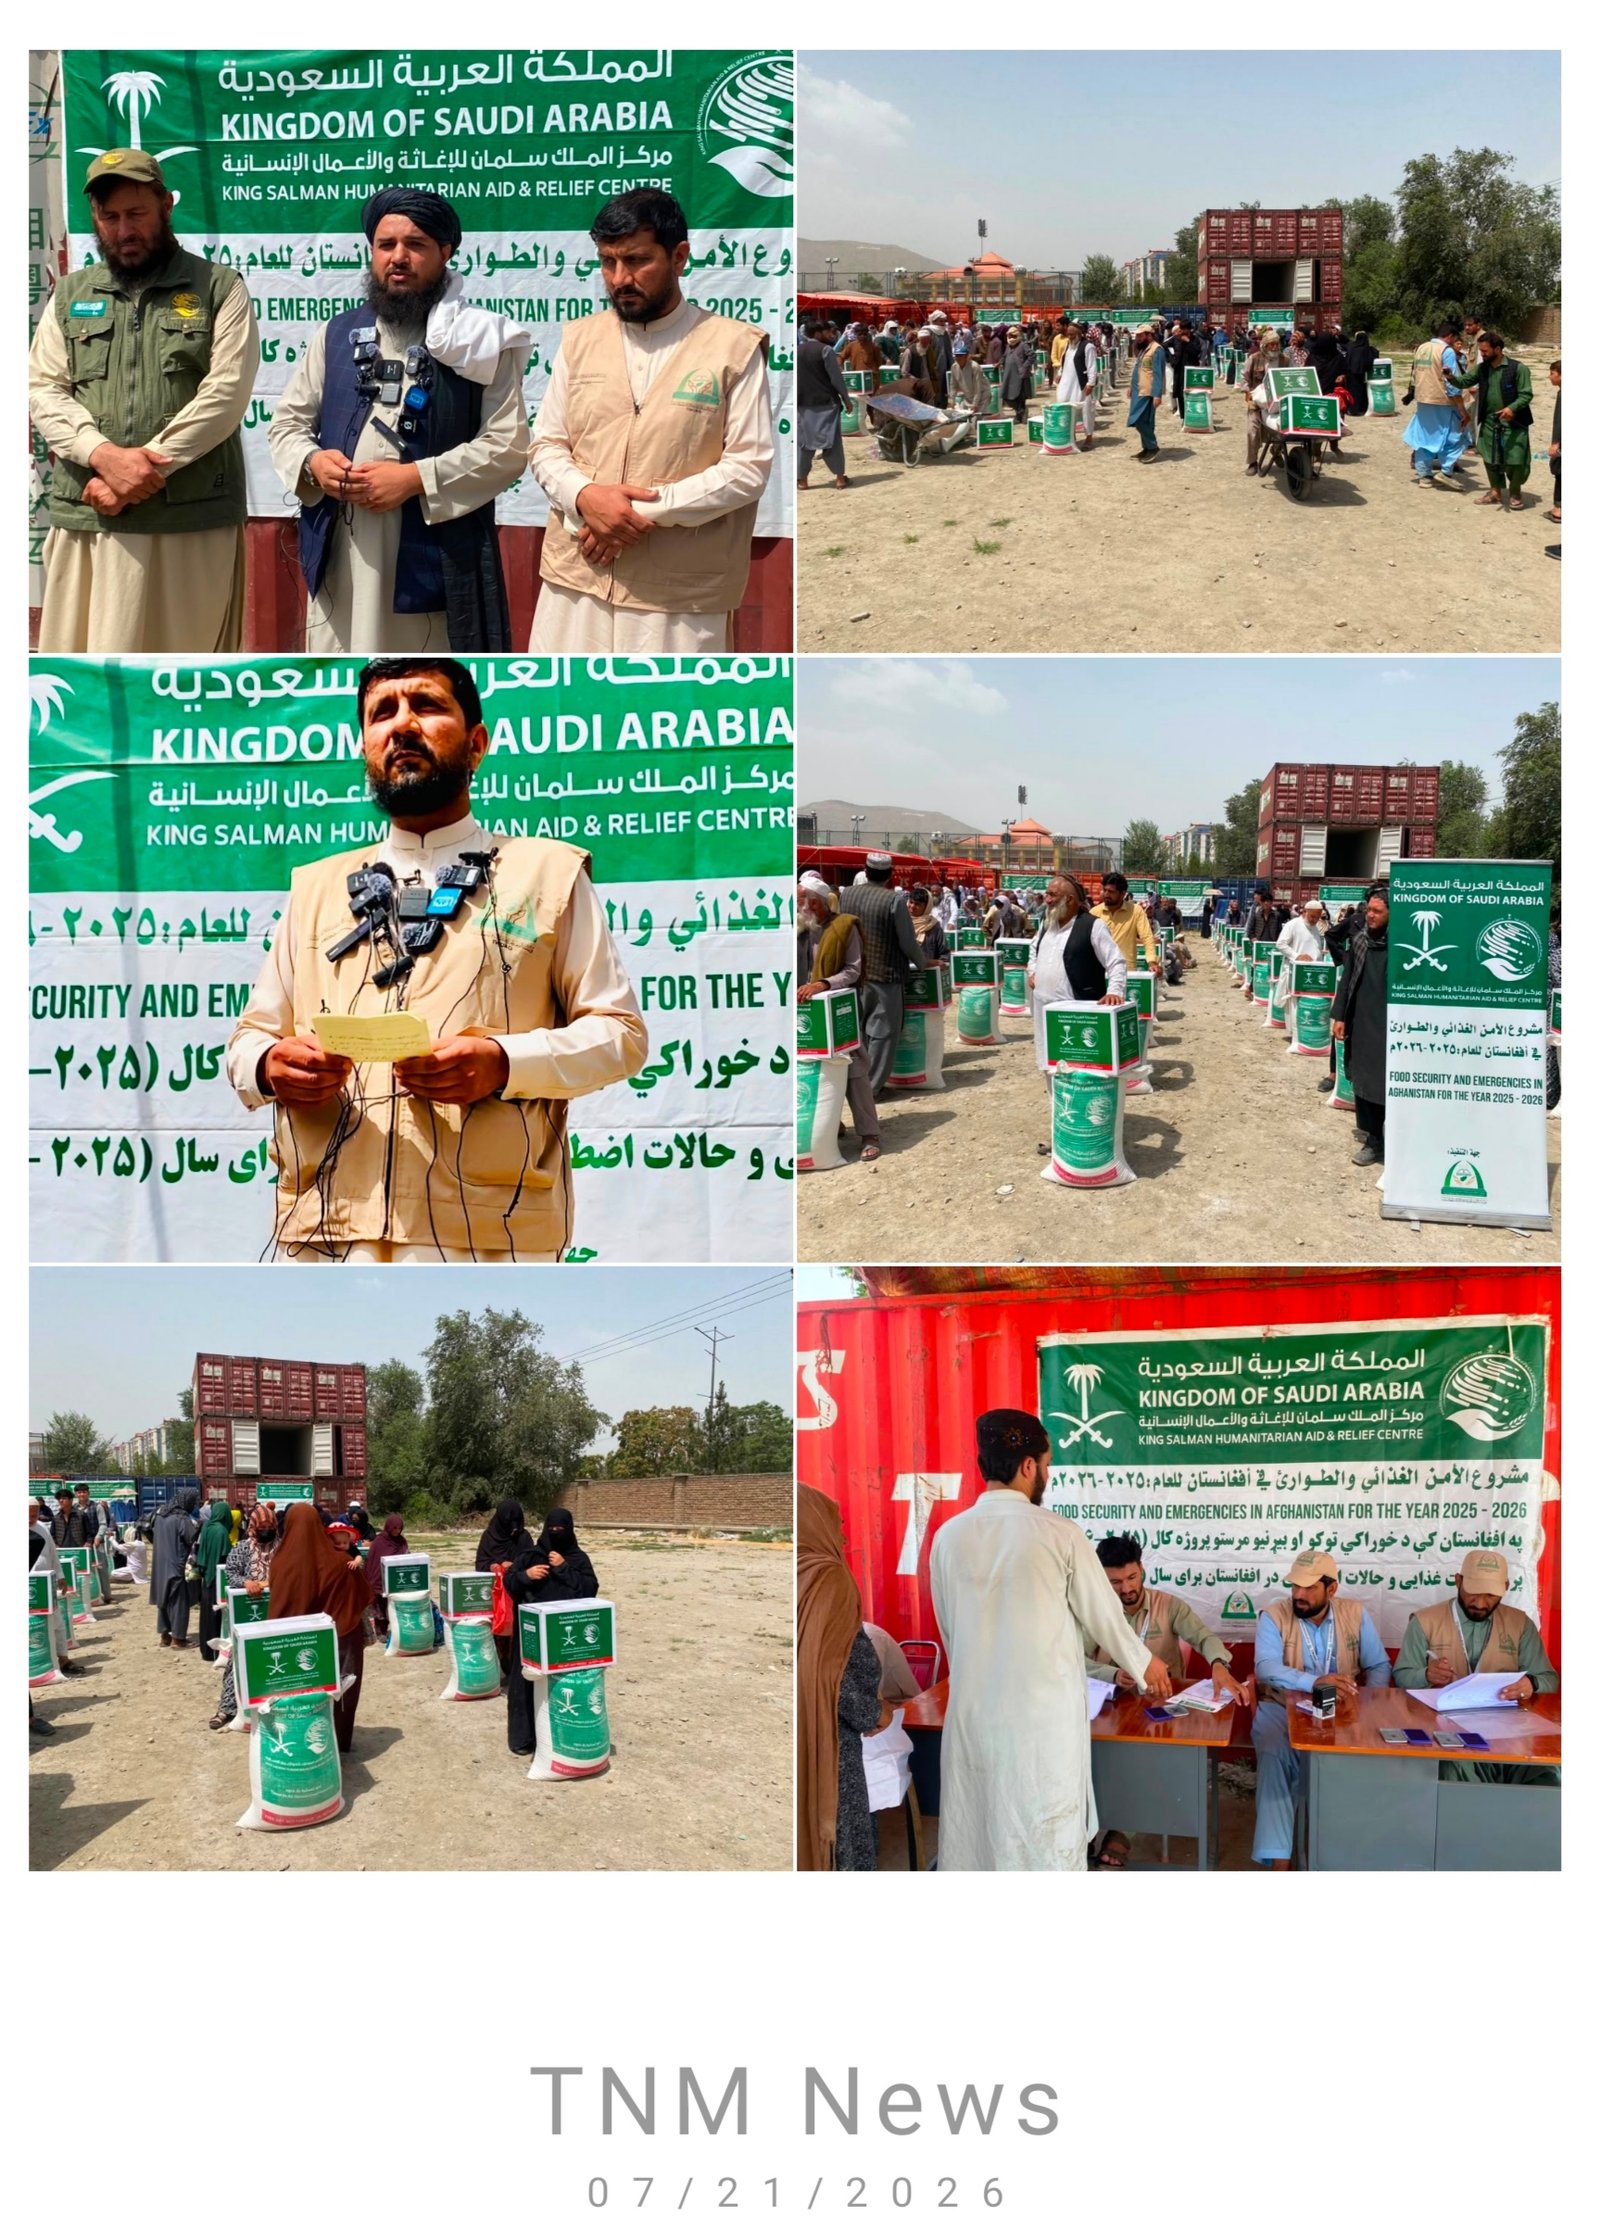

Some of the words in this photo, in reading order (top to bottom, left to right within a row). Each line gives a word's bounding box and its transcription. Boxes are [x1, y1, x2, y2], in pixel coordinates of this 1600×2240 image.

[524, 49, 672, 83] المملكة
[744, 50, 766, 61] CENTRE
[218, 59, 383, 101] السعودية
[393, 53, 512, 96] العربية
[221, 110, 375, 141] KINGDOM
[383, 108, 425, 137] OF
[434, 105, 534, 136] SAUDI
[543, 100, 673, 133] ARABIA
[221, 152, 308, 176] الإنسانية
[312, 149, 394, 174] والأعمال
[398, 148, 467, 172] للإغاثة
[471, 149, 548, 170] سلمان
[551, 146, 614, 167] الملك
[616, 145, 673, 168] مركز
[222, 185, 262, 201] KING
[267, 184, 339, 200] SALMAN
[485, 181, 515, 198] AID
[518, 181, 531, 197] &
[536, 179, 595, 197] RELIEF
[556, 298, 594, 322] FOR
[152, 723, 364, 764] KINGDOM
[484, 713, 602, 756] AUDI
[615, 706, 793, 750] ARABIA
[514, 772, 623, 800] سلمان
[629, 766, 716, 794] الملك
[722, 764, 793, 794] مركز
[148, 778, 277, 812] الإنسانية
[146, 824, 207, 846] KING
[214, 823, 322, 846] SALMAN
[535, 816, 579, 839] AID
[583, 815, 602, 837] &
[608, 811, 692, 836] RELIEF
[1393, 878, 1450, 890] السعودية
[1453, 878, 1493, 892] العربية
[1496, 879, 1544, 892] المملكة
[1393, 893, 1446, 904] KINGDOM
[1449, 894, 1464, 904] OF
[1466, 895, 1500, 905] SAUDI
[1502, 896, 1544, 906] ARABIA
[140, 983, 199, 1019] AND
[641, 974, 698, 1012] FOR
[705, 972, 764, 1009] THE
[1434, 993, 1480, 1001] HUMANITARIAN
[1508, 1023, 1543, 1037] مشروع
[1389, 1070, 1410, 1082] FOOD
[1412, 1072, 1451, 1084] SECURITY
[1453, 1074, 1471, 1086] AND
[1473, 1075, 1531, 1089] EMERGENCIES
[1534, 1078, 1543, 1089] IN
[1388, 1086, 1435, 1099] AGHANISTAN
[1437, 1089, 1452, 1100] FOR
[1454, 1090, 1469, 1101] THE
[1470, 1091, 1491, 1103] YEAR
[1492, 1093, 1514, 1104] 2025
[1521, 1094, 1543, 1106] 2026
[162, 1136, 219, 1184] سال
[643, 1131, 736, 1169] حالات
[747, 1147, 764, 1180] و
[1138, 1355, 1242, 1383] السعودية
[1248, 1352, 1325, 1380] العربية
[1331, 1348, 1425, 1371] المملكة
[1138, 1387, 1236, 1408] KINGDOM
[1241, 1386, 1269, 1405] OF
[1273, 1384, 1337, 1404] SAUDI
[1343, 1381, 1425, 1402] ARABIA
[1138, 1414, 1193, 1431] الإنسانية
[1195, 1411, 1248, 1428] والأعمال
[1250, 1410, 1294, 1427] للإغاثة
[1296, 1410, 1346, 1425] سلمان
[1348, 1410, 1387, 1423] الملك
[1389, 1409, 1424, 1423] مركز
[1138, 1434, 1164, 1445] KING
[1166, 1434, 1212, 1445] SALMAN
[1215, 1431, 1302, 1444] HUMANITARIAN
[1305, 1431, 1325, 1442] AID
[1327, 1431, 1335, 1441] &
[1337, 1430, 1376, 1441] RELIEF
[1377, 1428, 1424, 1440] CENTRE
[1187, 1467, 1251, 1492] أفغانستان
[1256, 1468, 1271, 1491] في
[1275, 1467, 1356, 1490] والطوارئ
[1361, 1466, 1418, 1493] الغذائي
[1425, 1463, 1469, 1490] الأمن
[1471, 1464, 1529, 1490] مشروع
[1081, 1504, 1136, 1520] SECURITY
[1139, 1504, 1163, 1520] AND
[1165, 1504, 1247, 1520] EMERGENCIES
[1250, 1504, 1263, 1519] IN
[1265, 1503, 1344, 1519] AFGHANISTAN
[1348, 1503, 1372, 1519] FOR
[1377, 1502, 1402, 1519] THE
[1406, 1502, 1440, 1519] YEAR
[1443, 1502, 1478, 1519] 2025
[1492, 1501, 1527, 1519] 2026
[1213, 1532, 1250, 1551] مرستو
[1290, 1530, 1303, 1551] او
[1439, 1530, 1505, 1553] افغانستان
[1149, 1567, 1172, 1585] سال
[1205, 1567, 1261, 1587] افغانستان
[1263, 1572, 1279, 1588] در
[1345, 1569, 1384, 1585] حالات
[1388, 1578, 1396, 1590] و
